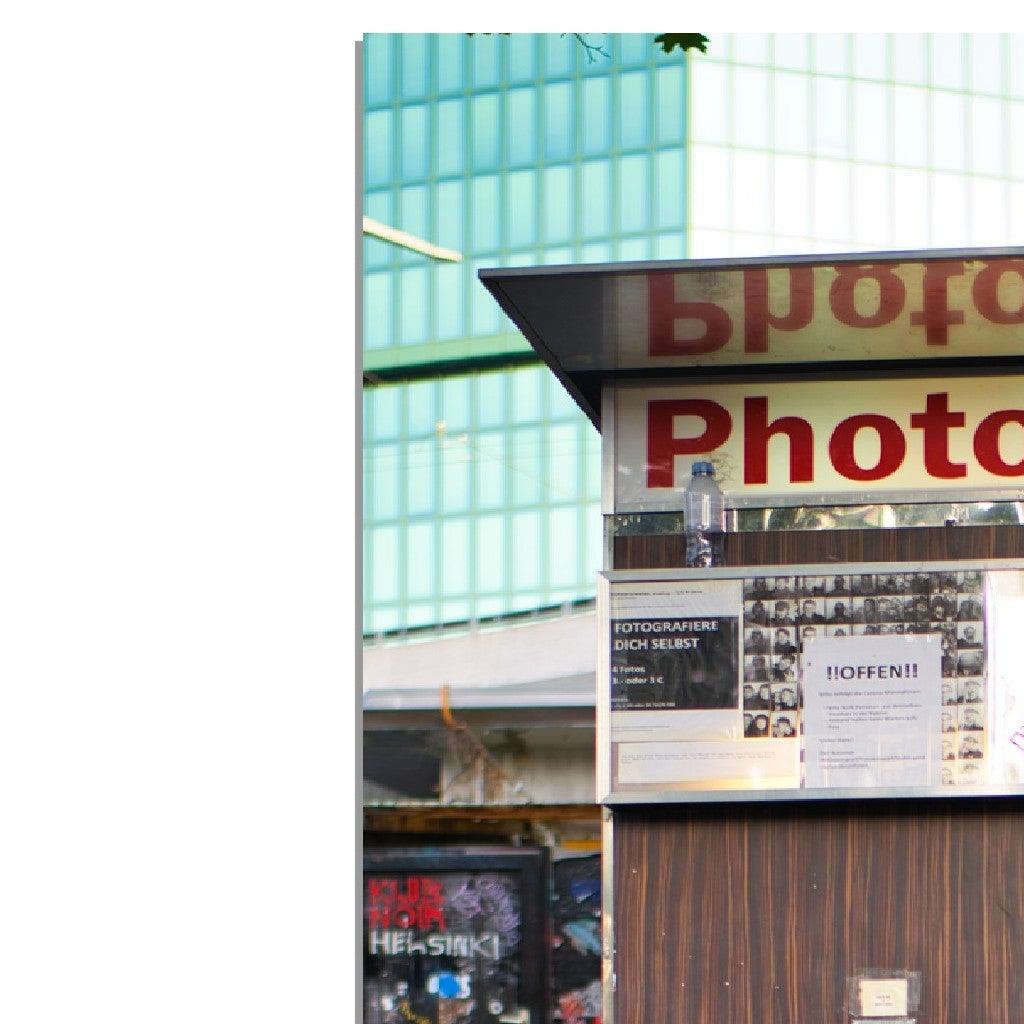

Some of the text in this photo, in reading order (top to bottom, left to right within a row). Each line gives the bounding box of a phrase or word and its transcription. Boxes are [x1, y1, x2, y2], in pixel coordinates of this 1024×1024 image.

[615, 621, 719, 634] FOTOGRAFIERE
[615, 638, 699, 651] DICH SELBST
[827, 663, 918, 680] !!OFFEN!!
